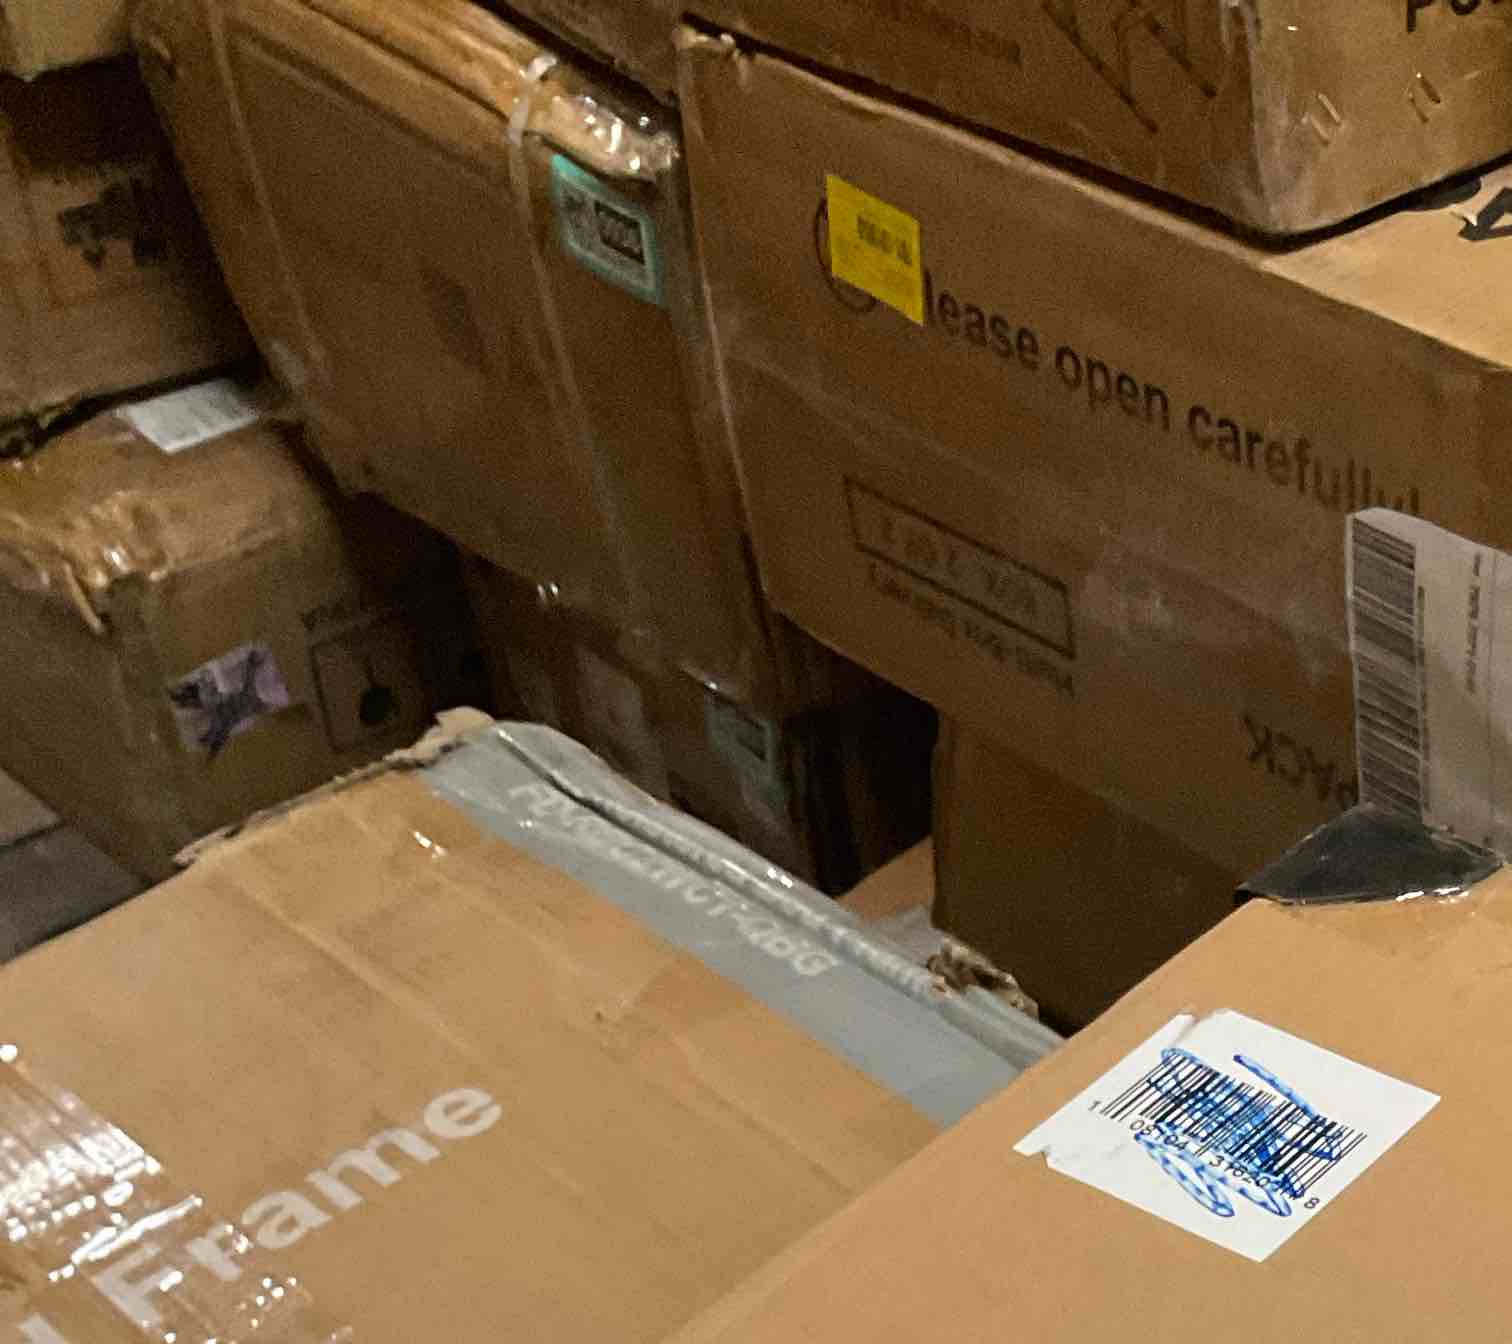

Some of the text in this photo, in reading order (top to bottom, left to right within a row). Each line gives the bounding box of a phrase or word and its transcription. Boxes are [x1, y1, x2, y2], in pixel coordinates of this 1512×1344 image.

[924, 271, 1041, 373] lease
[1056, 342, 1172, 432] open
[90, 1088, 502, 1327] Frame
